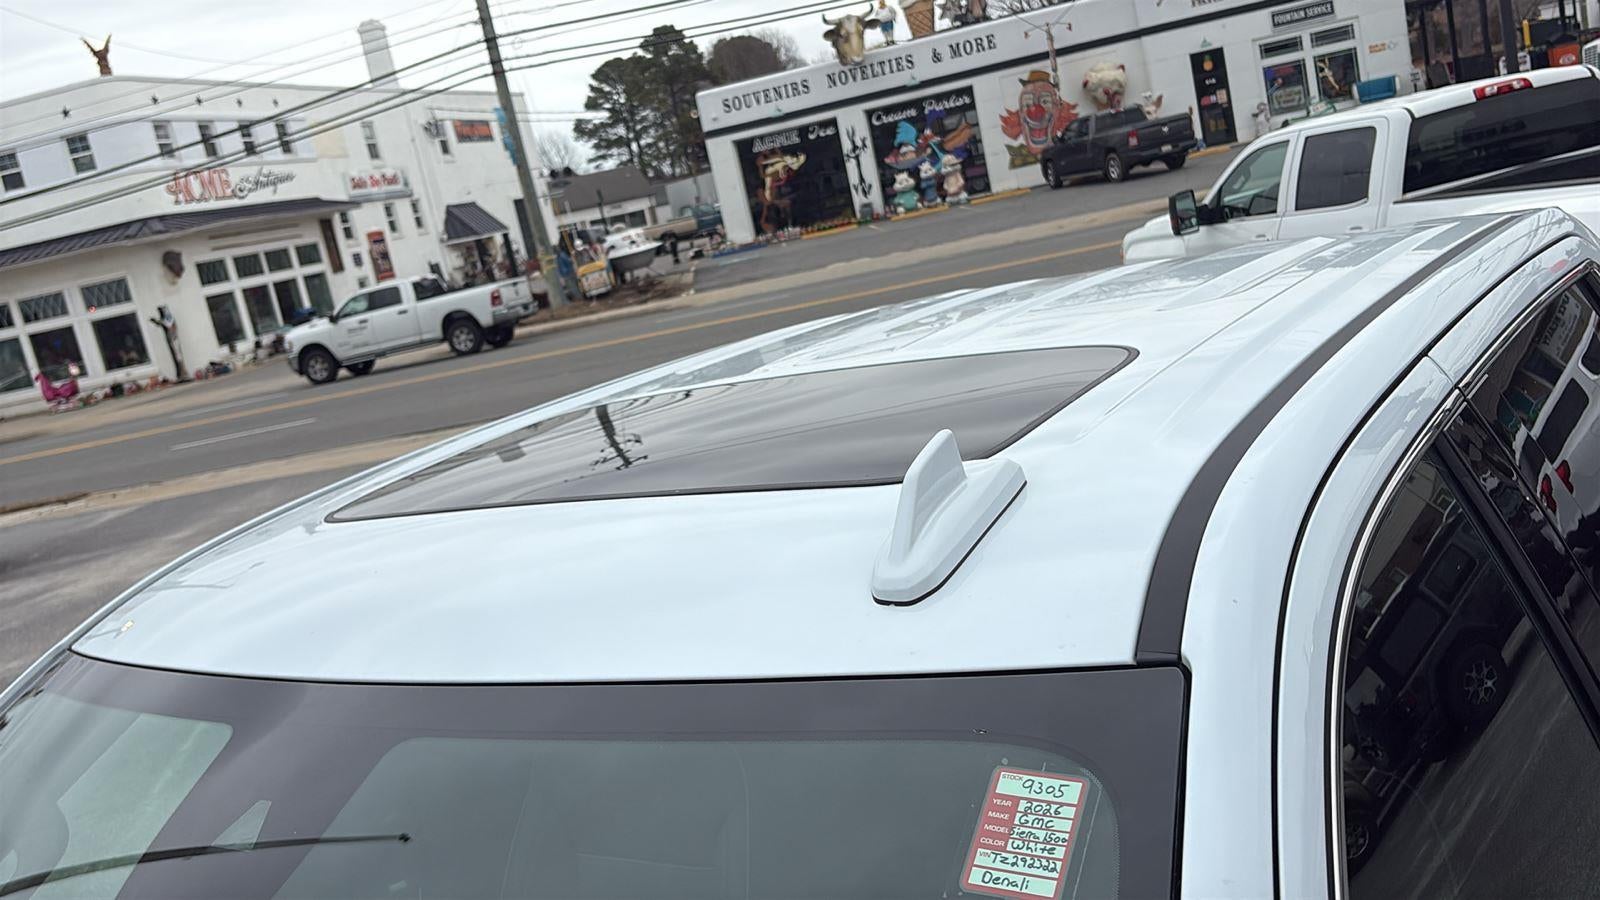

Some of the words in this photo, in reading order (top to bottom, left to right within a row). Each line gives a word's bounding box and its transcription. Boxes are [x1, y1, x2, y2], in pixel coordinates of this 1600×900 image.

[1273, 12, 1306, 26] FOUNTAIN
[1306, 5, 1332, 19] SERVICE
[722, 79, 811, 113] SOUVENIRS
[826, 54, 915, 88] NOVELTIES
[931, 48, 944, 64] &
[948, 33, 998, 60] MORE
[871, 108, 918, 126] Cream
[923, 94, 972, 113] Parlor
[752, 130, 800, 153] ACME
[165, 168, 234, 205] ACME
[1022, 778, 1070, 798] 9305
[987, 811, 1010, 820] MAKE
[992, 798, 1013, 807] YEAR
[1024, 801, 1064, 816] 2026
[983, 823, 1010, 834] MODEL
[1009, 825, 1040, 841] Sierra
[1043, 832, 1068, 844] 1500
[979, 837, 1006, 847] COLOR
[1011, 840, 1057, 855] White
[981, 871, 1030, 891] Denali
